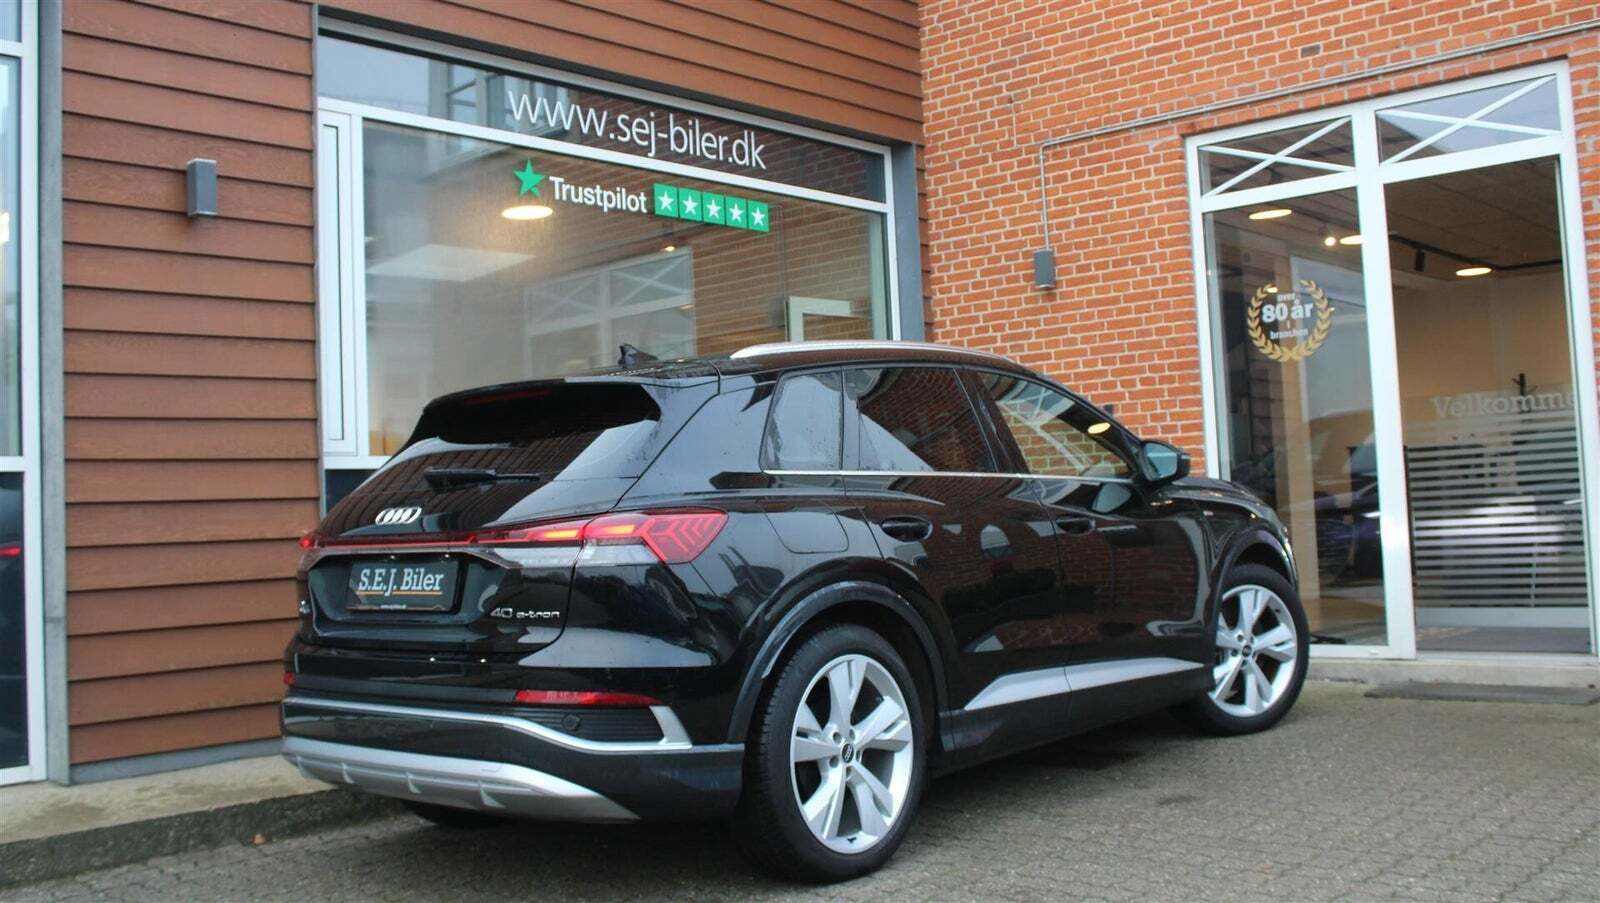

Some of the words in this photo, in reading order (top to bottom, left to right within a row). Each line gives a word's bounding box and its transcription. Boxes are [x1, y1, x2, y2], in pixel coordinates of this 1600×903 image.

[508, 91, 767, 170] www.sej-biler.dk
[549, 176, 648, 213] Trustpilot
[1262, 302, 1288, 323] 80
[1291, 299, 1314, 319] år
[358, 567, 398, 597] S.E.J.
[400, 566, 445, 591] Biler
[490, 607, 513, 619] 40
[516, 609, 561, 619] e-tron
